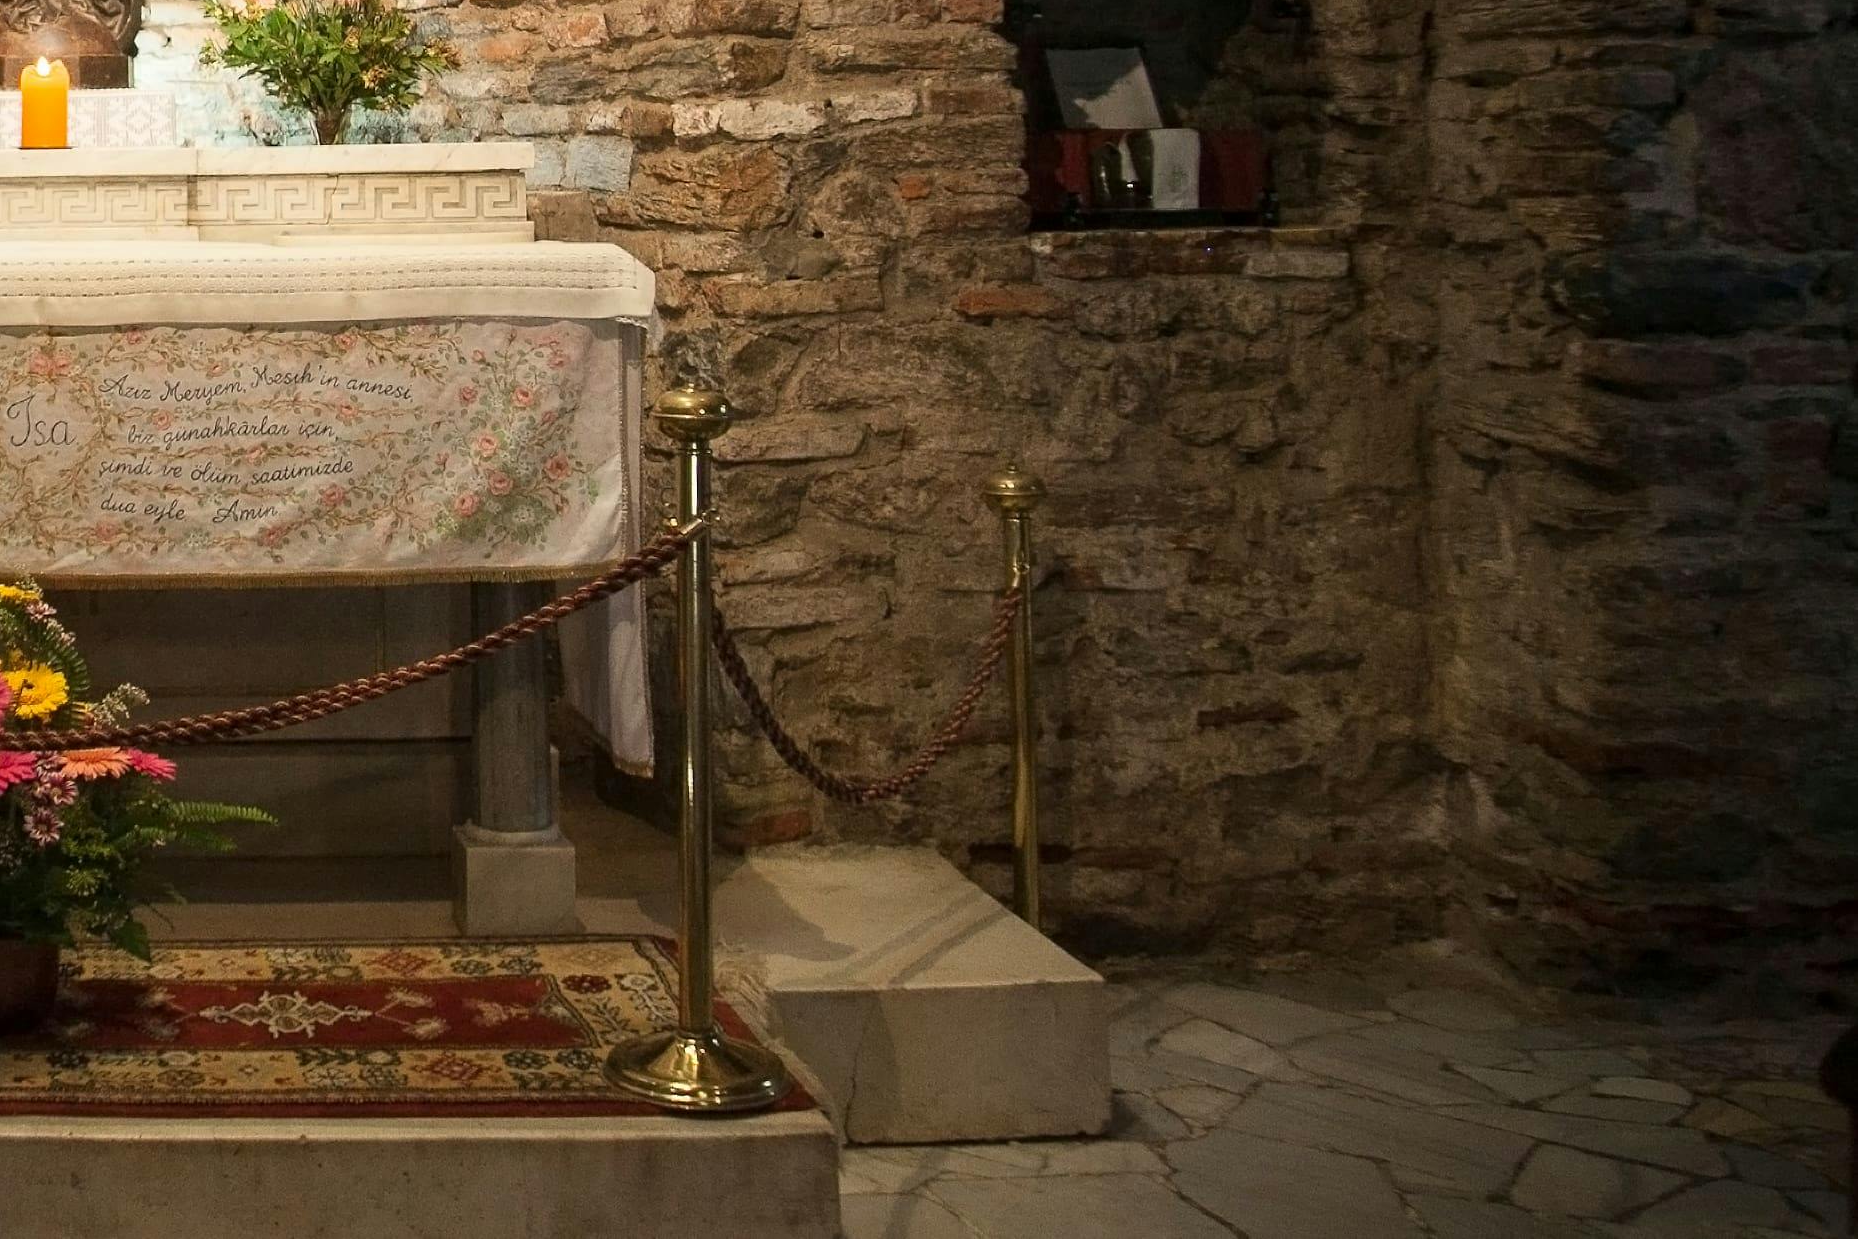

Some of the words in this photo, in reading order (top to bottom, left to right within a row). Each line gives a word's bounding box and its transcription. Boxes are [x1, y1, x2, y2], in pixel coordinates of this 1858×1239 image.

[127, 424, 155, 446] biz
[98, 456, 152, 479] şimdi
[162, 464, 183, 479] ve
[190, 461, 241, 484] ölüm
[100, 492, 138, 514] dua
